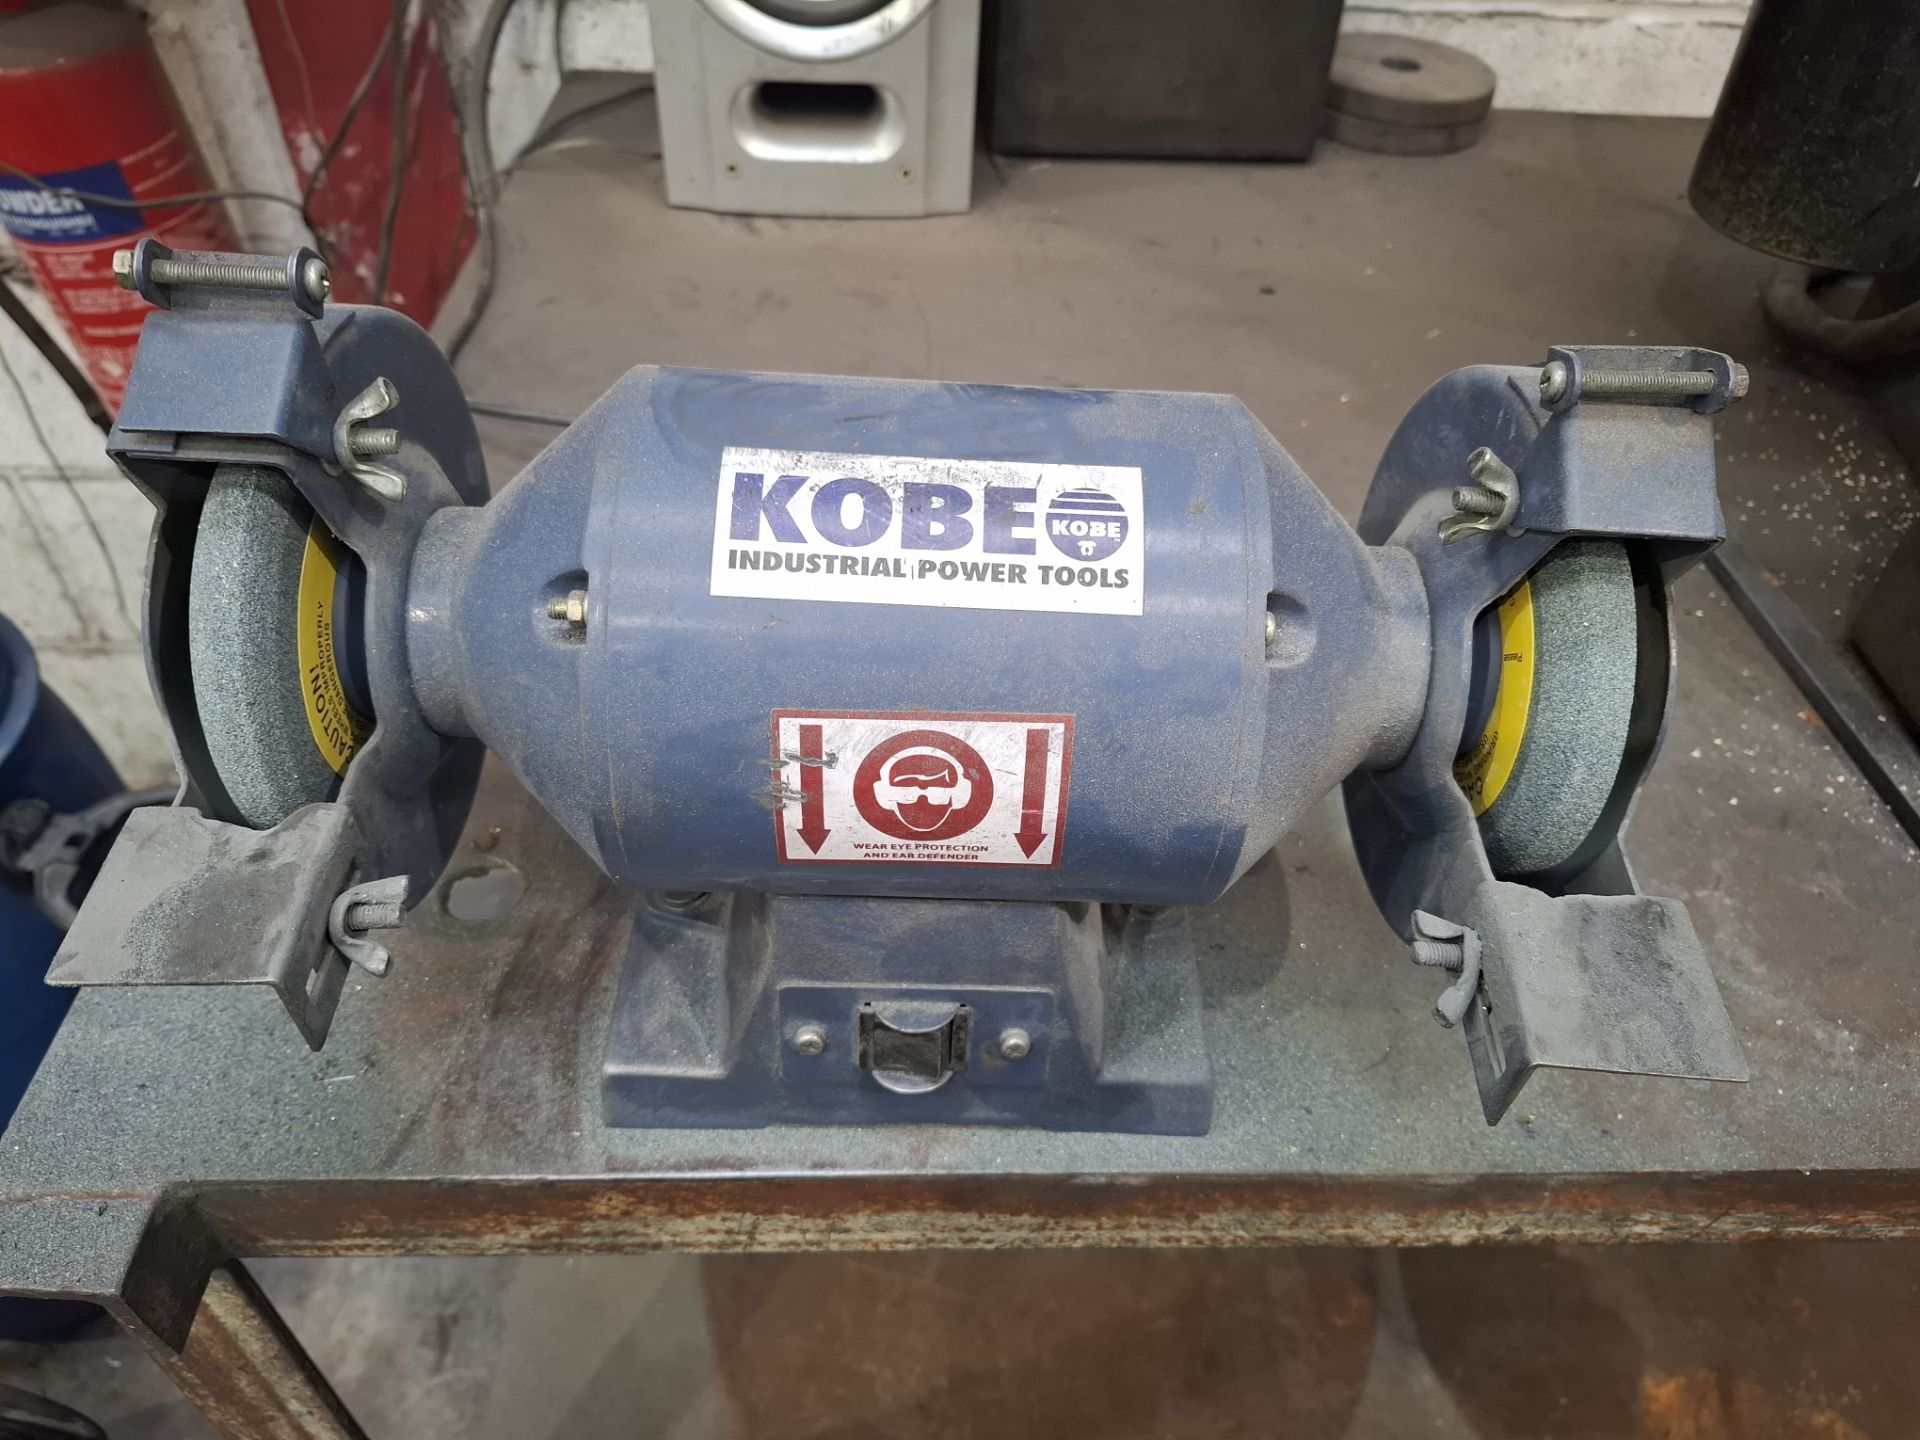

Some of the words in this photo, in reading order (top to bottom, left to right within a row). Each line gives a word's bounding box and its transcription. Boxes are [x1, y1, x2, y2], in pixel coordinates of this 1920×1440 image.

[729, 472, 1038, 556] KOBE
[1051, 517, 1121, 538] KOBE
[728, 549, 907, 579] INDUSTRIAL
[917, 559, 1028, 585] POWER
[1037, 565, 1130, 589] TOOLS
[309, 663, 353, 764] CAUTION!
[853, 842, 888, 850] WEAR
[915, 844, 989, 852] PROTECTION
